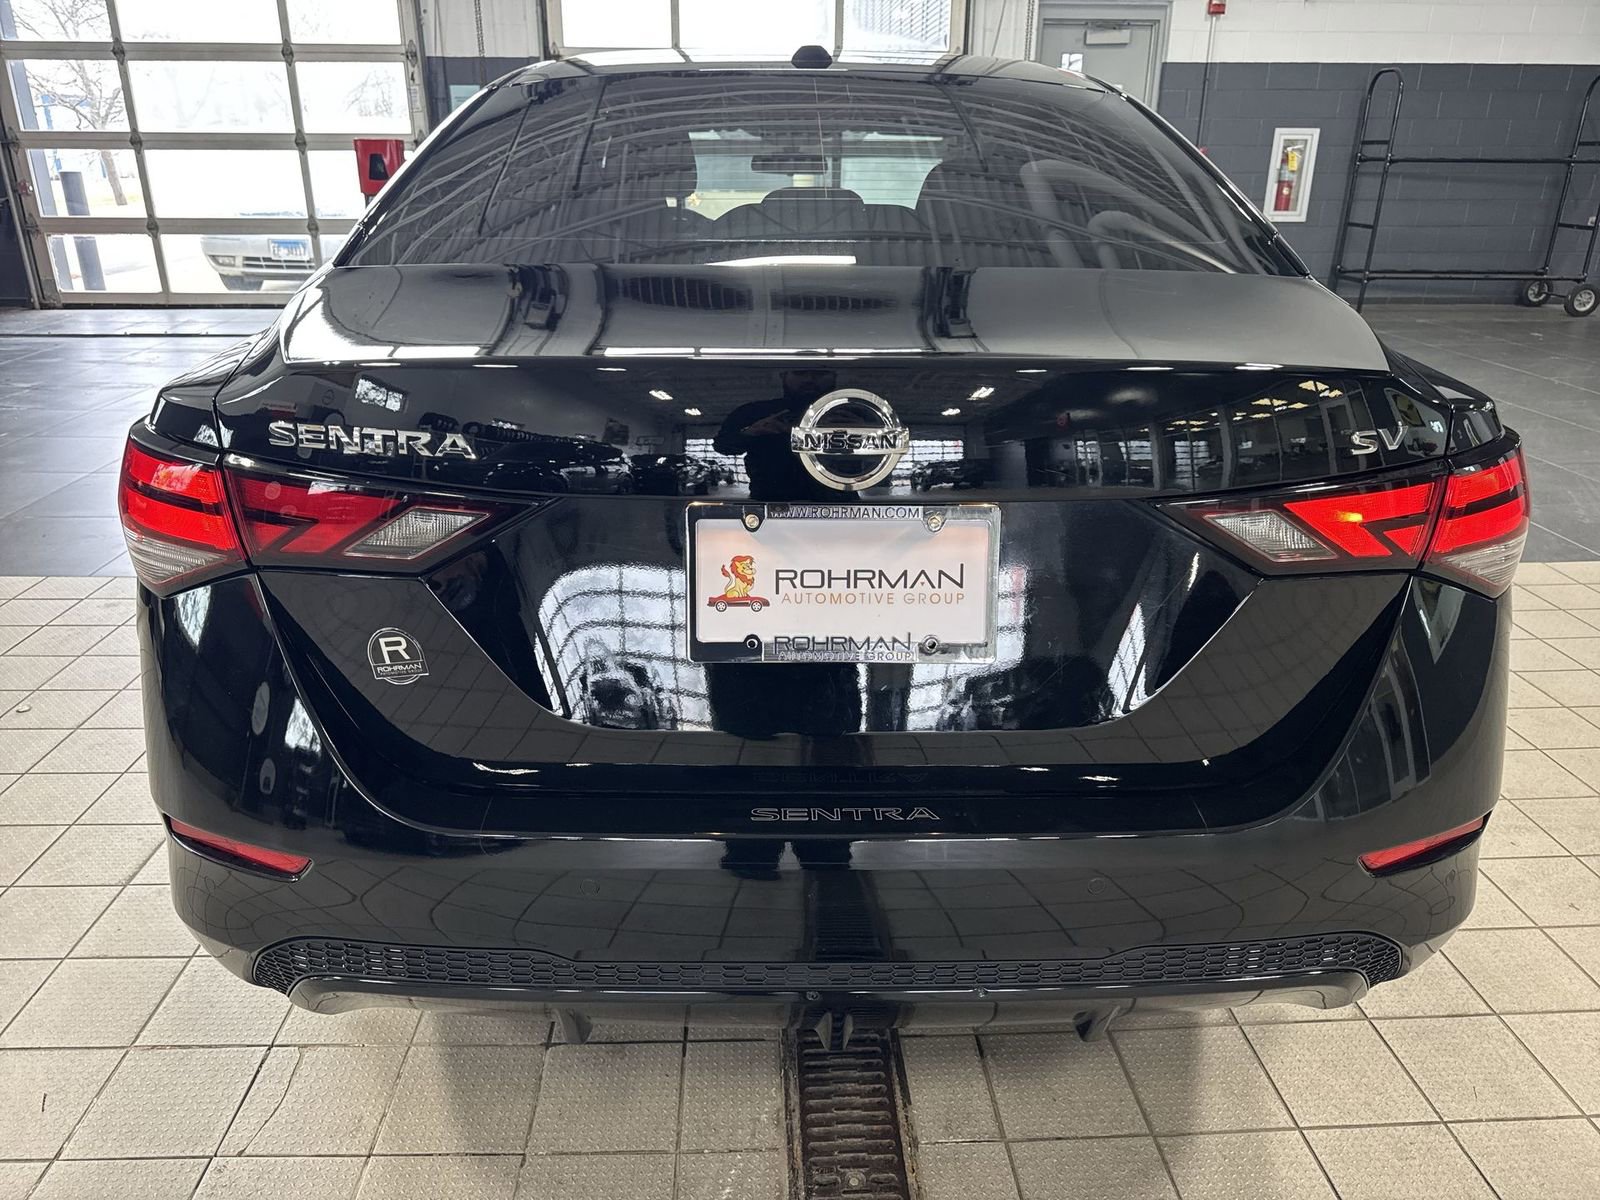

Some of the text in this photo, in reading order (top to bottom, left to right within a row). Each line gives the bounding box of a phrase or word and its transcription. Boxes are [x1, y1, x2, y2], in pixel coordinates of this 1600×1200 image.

[268, 420, 477, 460] SENTRA
[803, 432, 898, 450] NISSAN
[1350, 421, 1408, 455] SV
[775, 563, 964, 595] ROHRMAN
[781, 592, 965, 605] AUTOMOTIVE GROUP
[379, 636, 410, 664] R
[774, 632, 911, 654] ROHRMAN
[868, 651, 912, 662] GROUP
[377, 662, 422, 674] ROHRMAN
[750, 807, 940, 821] SENTRA
